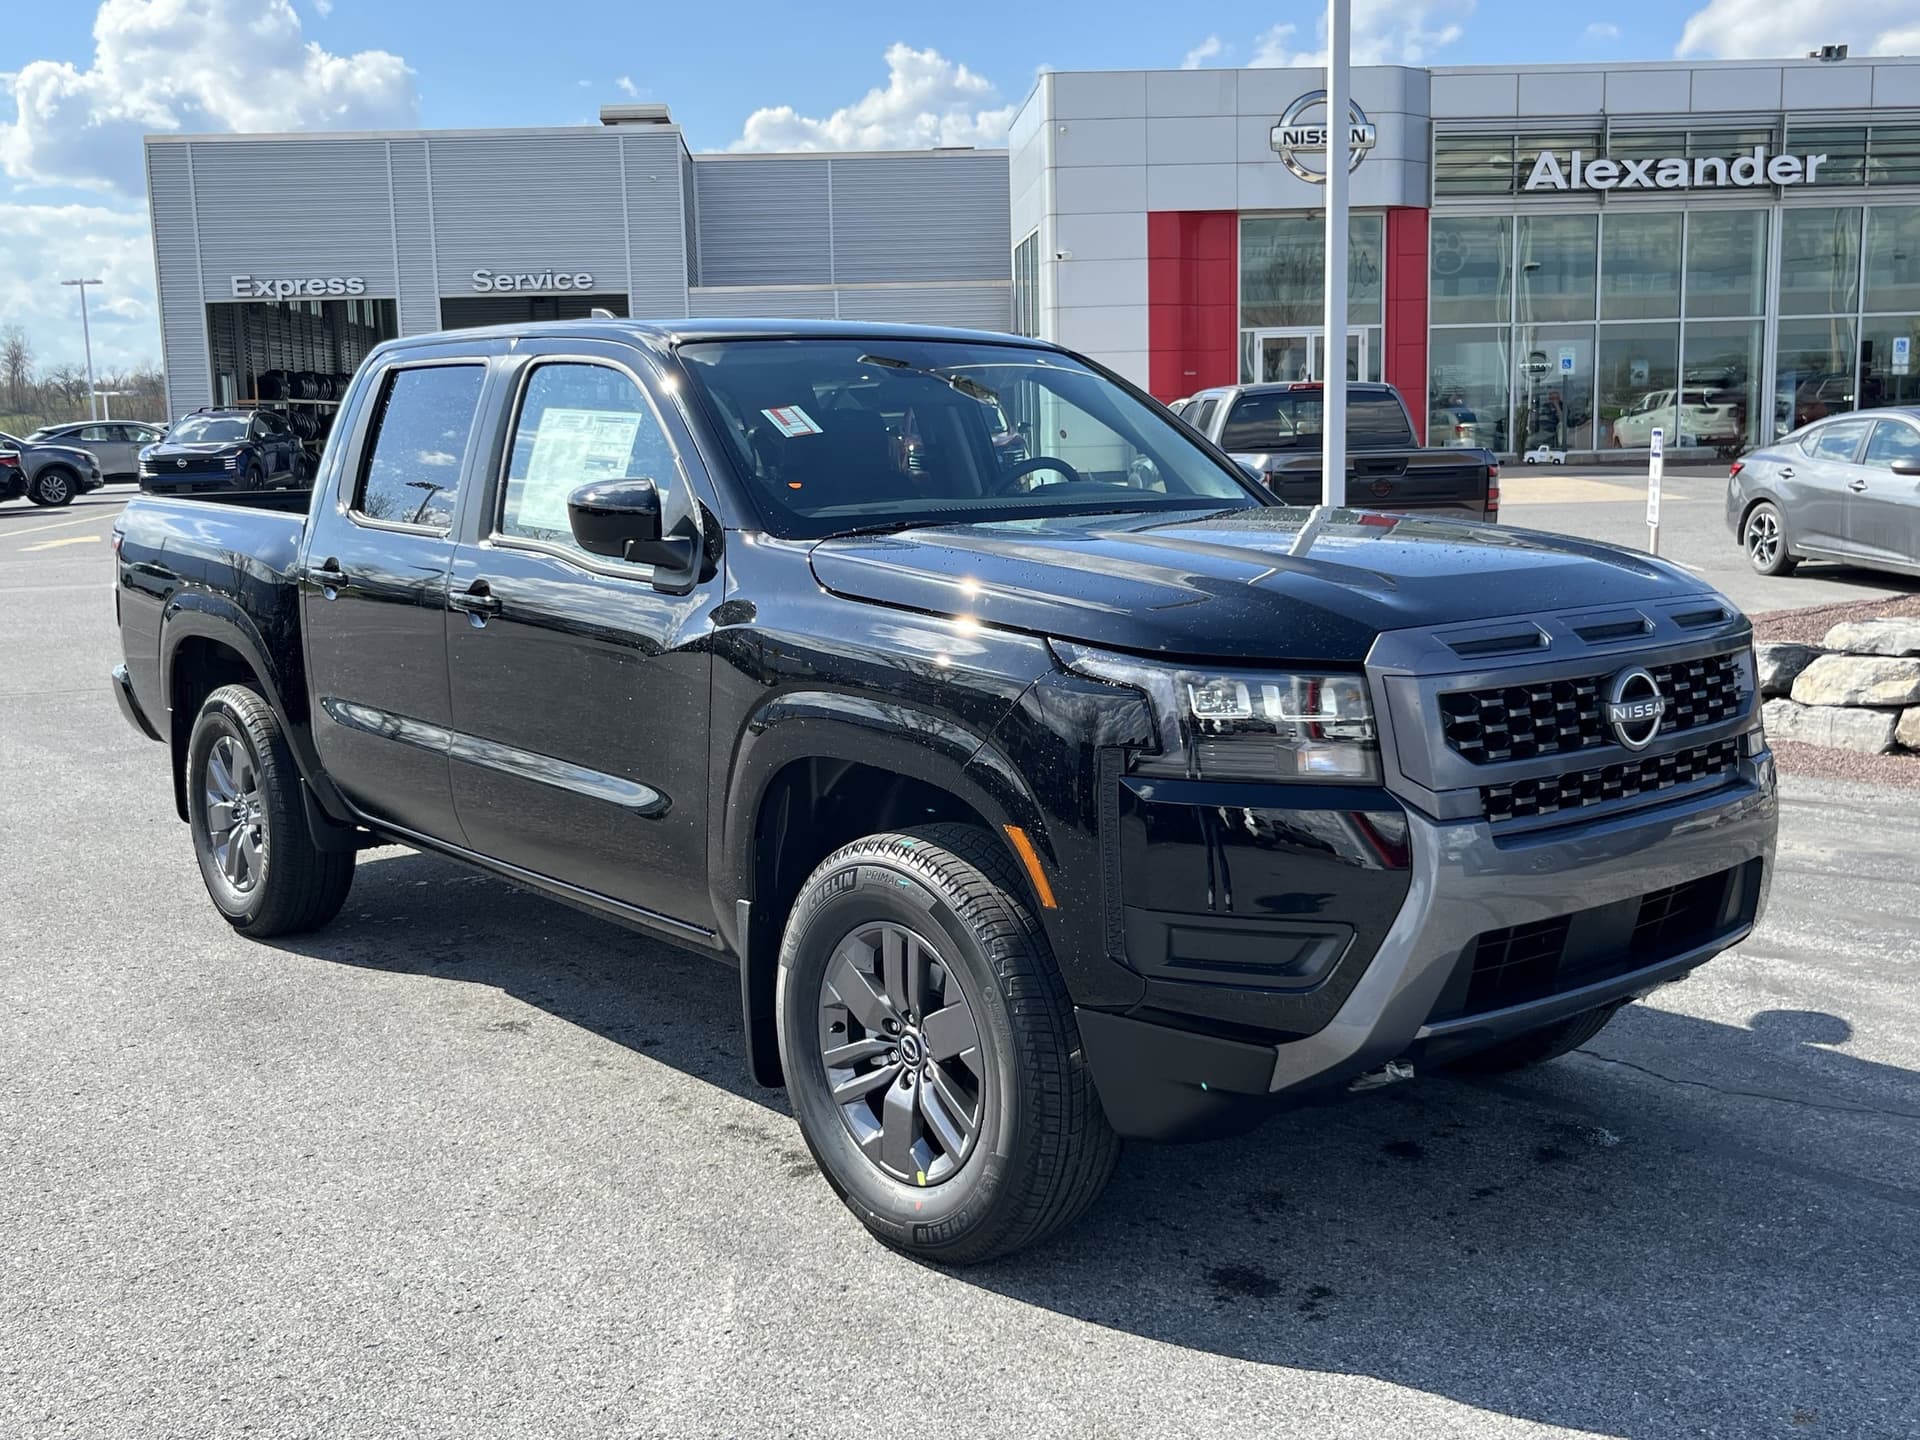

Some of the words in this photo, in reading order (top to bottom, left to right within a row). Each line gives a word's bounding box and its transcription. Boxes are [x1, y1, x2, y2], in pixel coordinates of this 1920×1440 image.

[1283, 129, 1366, 145] NISN
[1524, 146, 1828, 190] Alexander
[230, 275, 366, 300] Express
[471, 268, 594, 292] Service
